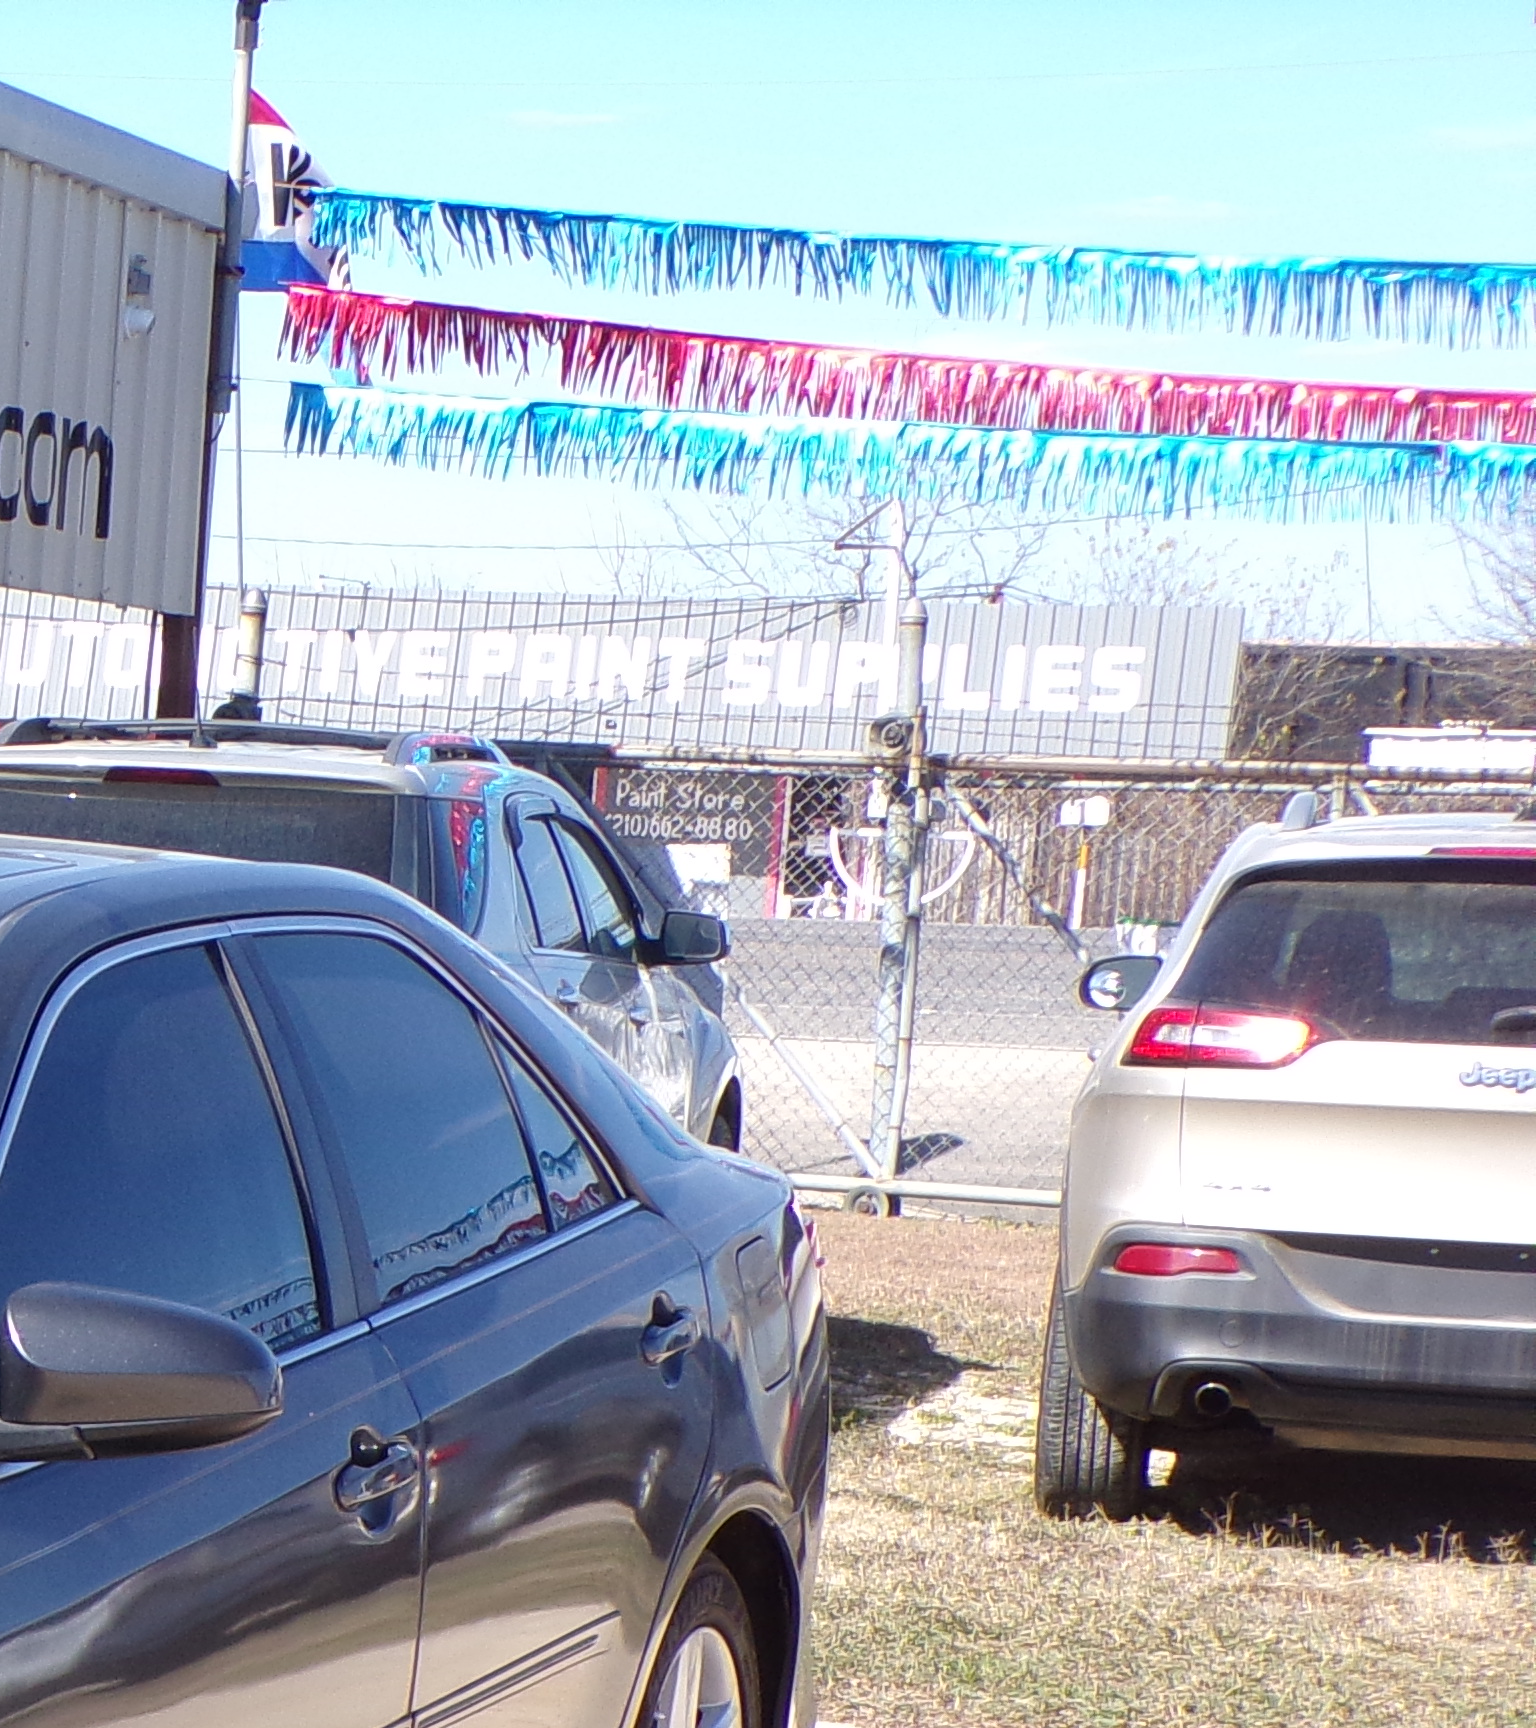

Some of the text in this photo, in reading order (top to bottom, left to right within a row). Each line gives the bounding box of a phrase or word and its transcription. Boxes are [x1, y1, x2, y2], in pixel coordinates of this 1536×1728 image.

[467, 632, 707, 704] PAINT
[615, 779, 746, 811] Paint Store
[1459, 1062, 1536, 1094] Jeep
